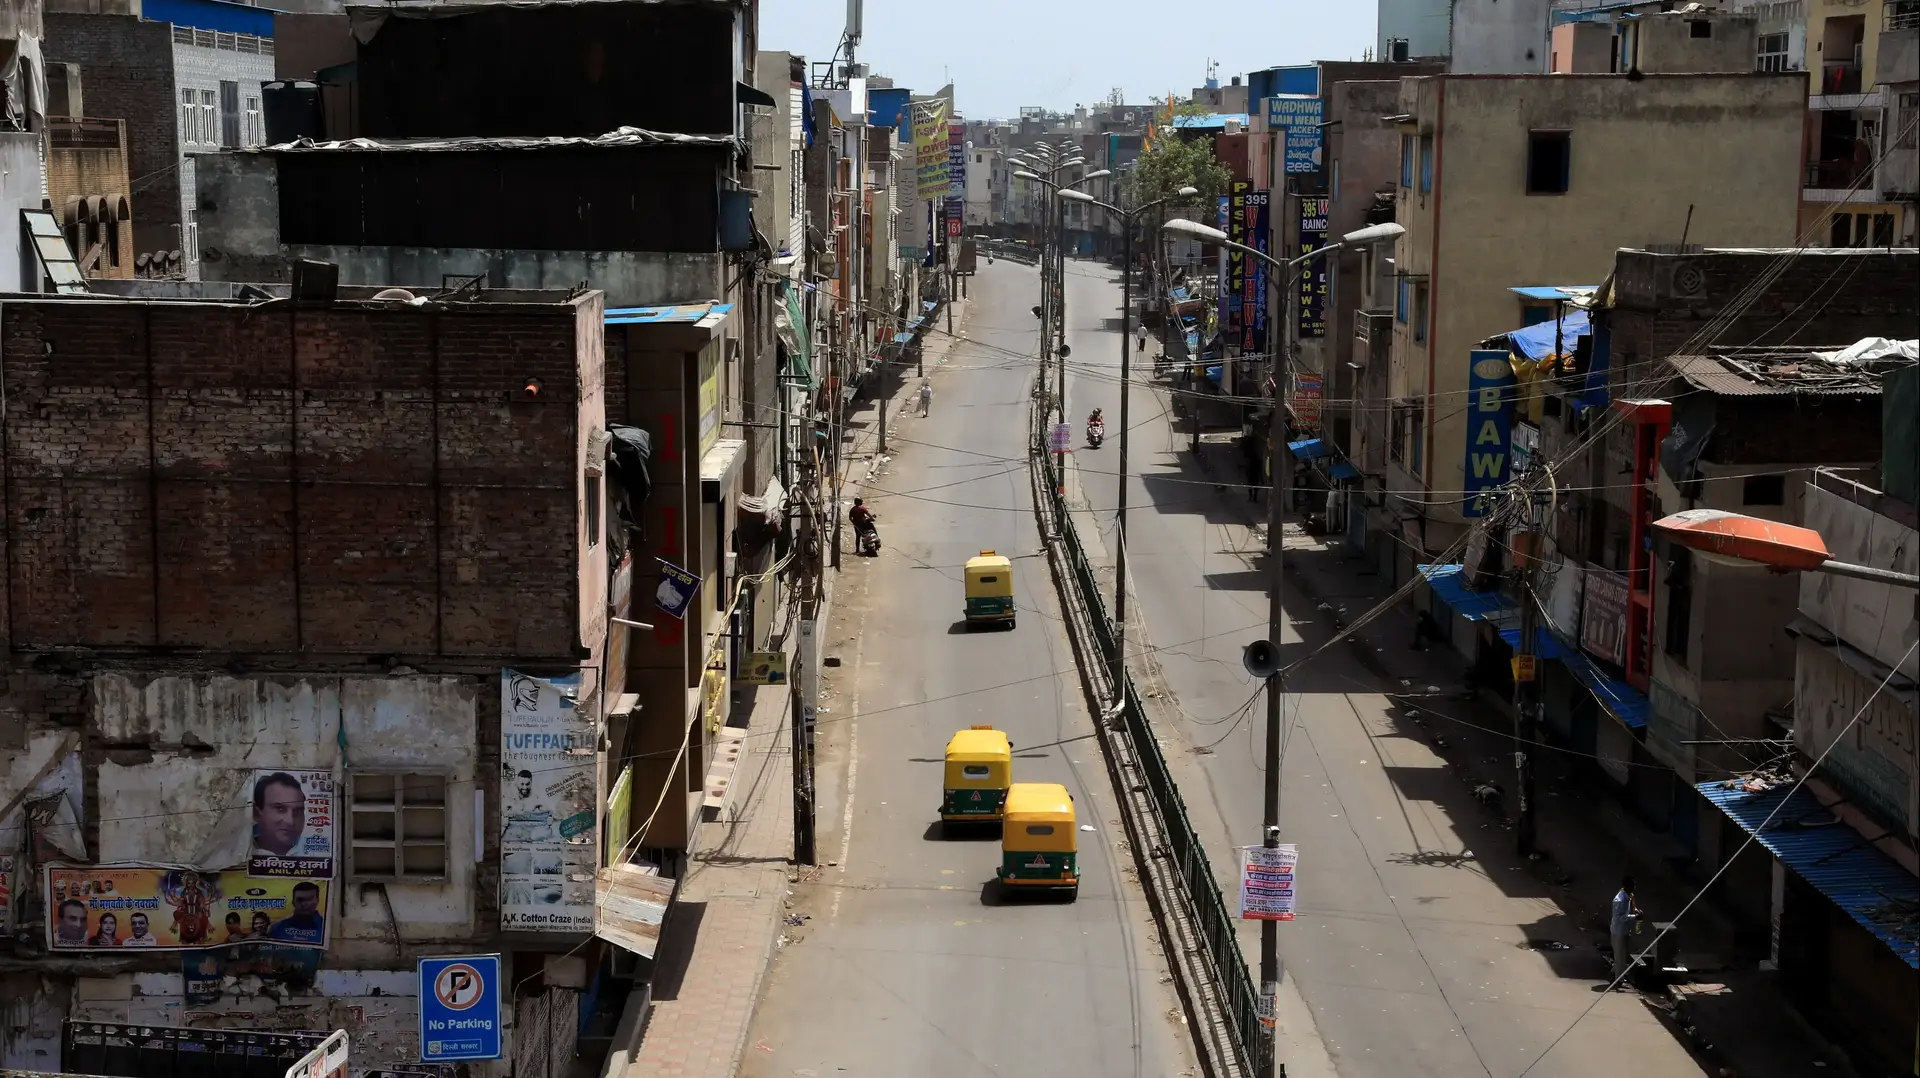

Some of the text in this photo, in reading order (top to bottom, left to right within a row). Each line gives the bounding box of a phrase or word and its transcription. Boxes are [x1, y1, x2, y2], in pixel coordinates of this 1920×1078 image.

[1272, 101, 1321, 114] WADHWA
[1271, 115, 1292, 124] RAIN
[1246, 195, 1267, 205] 395
[1302, 203, 1316, 217] 395
[948, 222, 961, 233] 161
[1302, 219, 1328, 230] RAINC
[503, 733, 595, 749] TUFFPAULIN
[253, 857, 329, 869] अनिल शर्मा
[521, 914, 547, 922] Cotton
[550, 914, 572, 923] Craze
[428, 1018, 492, 1030] No Parking
[442, 1043, 458, 1051] दिल्ली
